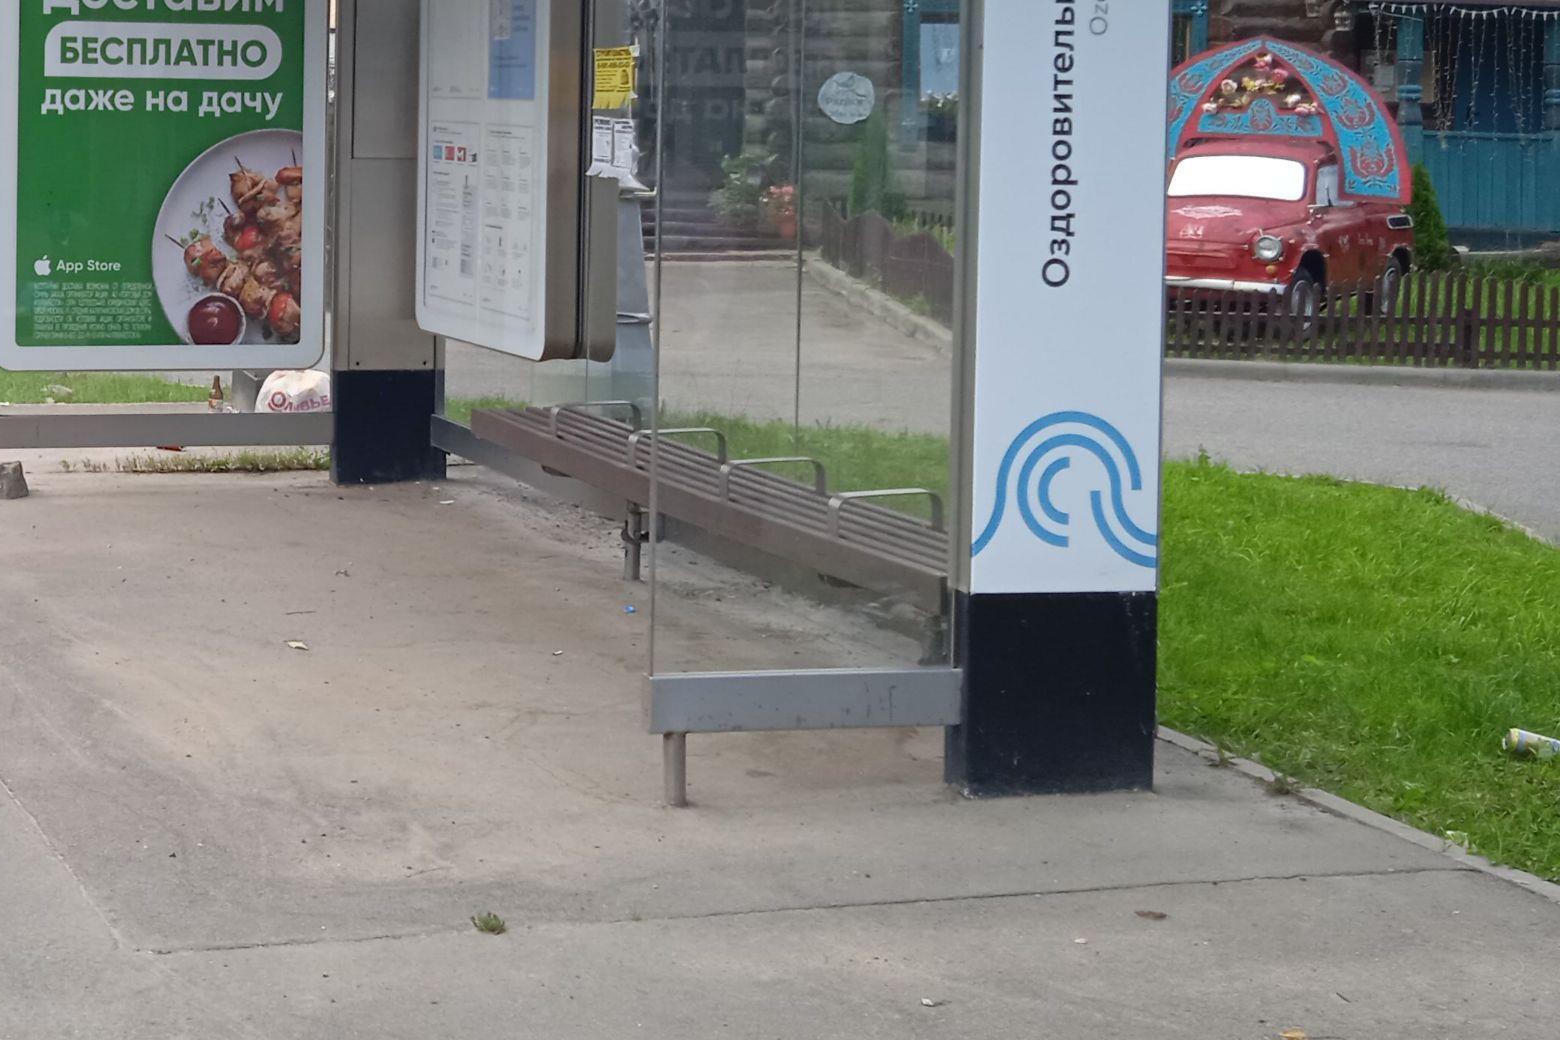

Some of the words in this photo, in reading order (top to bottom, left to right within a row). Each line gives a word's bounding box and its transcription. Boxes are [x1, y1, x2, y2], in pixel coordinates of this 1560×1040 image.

[59, 36, 268, 68] БЕСПЛАТНО
[40, 88, 135, 116] даже
[145, 90, 189, 112] на
[197, 91, 284, 120] дачу
[56, 259, 84, 274] App
[86, 259, 121, 271] Store
